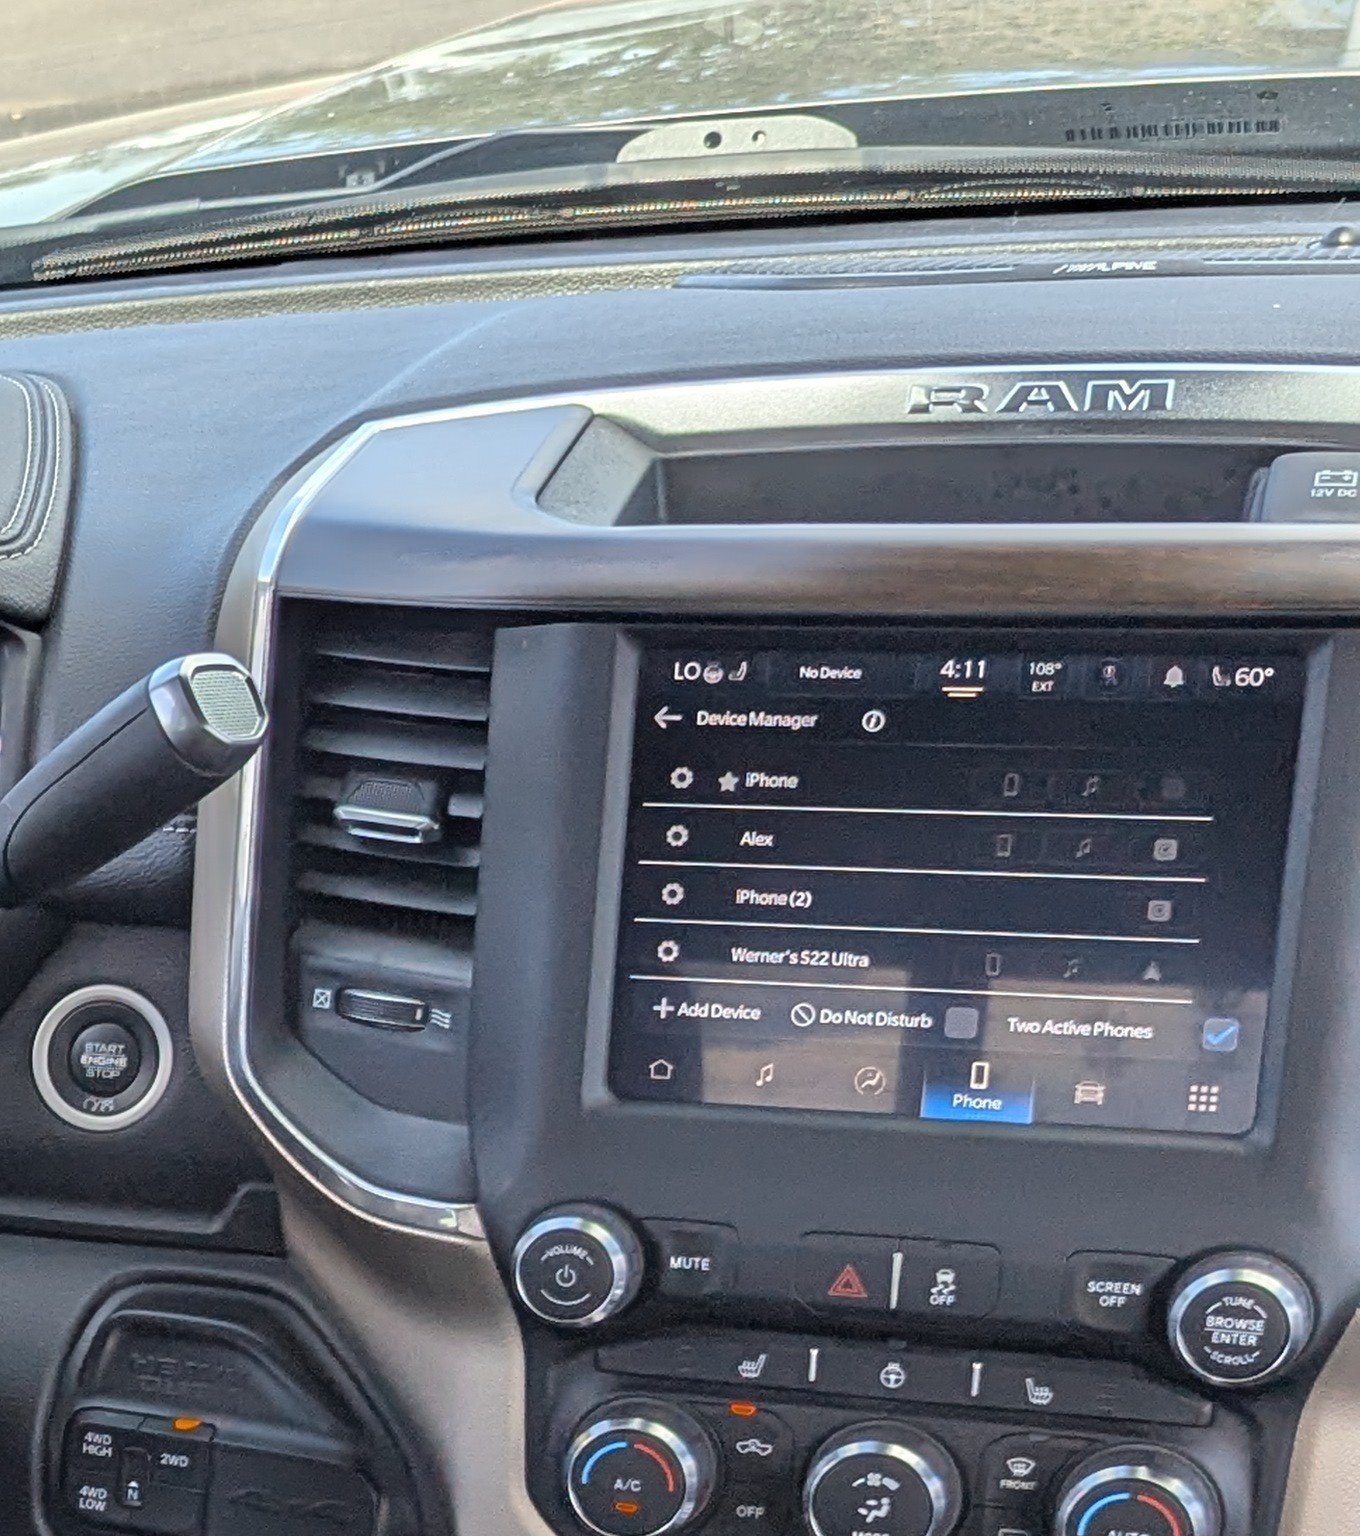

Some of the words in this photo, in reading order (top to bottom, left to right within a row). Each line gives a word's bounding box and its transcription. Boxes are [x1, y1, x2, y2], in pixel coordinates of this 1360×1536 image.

[907, 379, 1175, 414] RAM
[1310, 488, 1334, 498] 12V
[1337, 488, 1358, 498] DC
[674, 662, 700, 680] LO
[800, 666, 818, 679] No
[820, 667, 862, 680] Device
[940, 660, 985, 678] 4:11
[1032, 681, 1054, 693] EXT
[697, 710, 747, 726] Device
[749, 711, 818, 730] Manager
[745, 772, 799, 788] iPhone
[740, 831, 774, 847] Alex
[736, 889, 787, 906] iPhone
[788, 890, 812, 908] (2)
[731, 948, 799, 965] Werner's
[799, 950, 829, 966] S22
[832, 952, 870, 968] Ultra
[677, 1003, 709, 1018] Add
[711, 1004, 761, 1020] Device
[820, 1009, 843, 1025] Do
[844, 1010, 874, 1026] Not
[875, 1011, 933, 1029] Disturb
[1008, 1017, 1040, 1033] Two
[1042, 1018, 1091, 1036] Active
[1093, 1021, 1154, 1040] Phones
[85, 1042, 125, 1053] START
[86, 1070, 120, 1079] STOP
[952, 1093, 1002, 1110] Phone
[547, 1244, 588, 1260] VOLUME
[670, 1256, 711, 1271] MUTE
[1087, 1281, 1143, 1295] SCREEN
[1099, 1296, 1127, 1308] OFF
[1222, 1296, 1255, 1310] TUNE
[1206, 1315, 1265, 1331] BROWSE
[1211, 1331, 1259, 1346] ENTER
[1209, 1351, 1255, 1365] SCROLL
[84, 1431, 112, 1445] 4WD
[82, 1443, 113, 1458] HIGH
[160, 1453, 189, 1467] 2WD
[79, 1485, 107, 1499] 4WD
[613, 1479, 641, 1492] A/C
[127, 1488, 138, 1500] N
[79, 1498, 106, 1511] LOW
[736, 1505, 764, 1519] OFF
